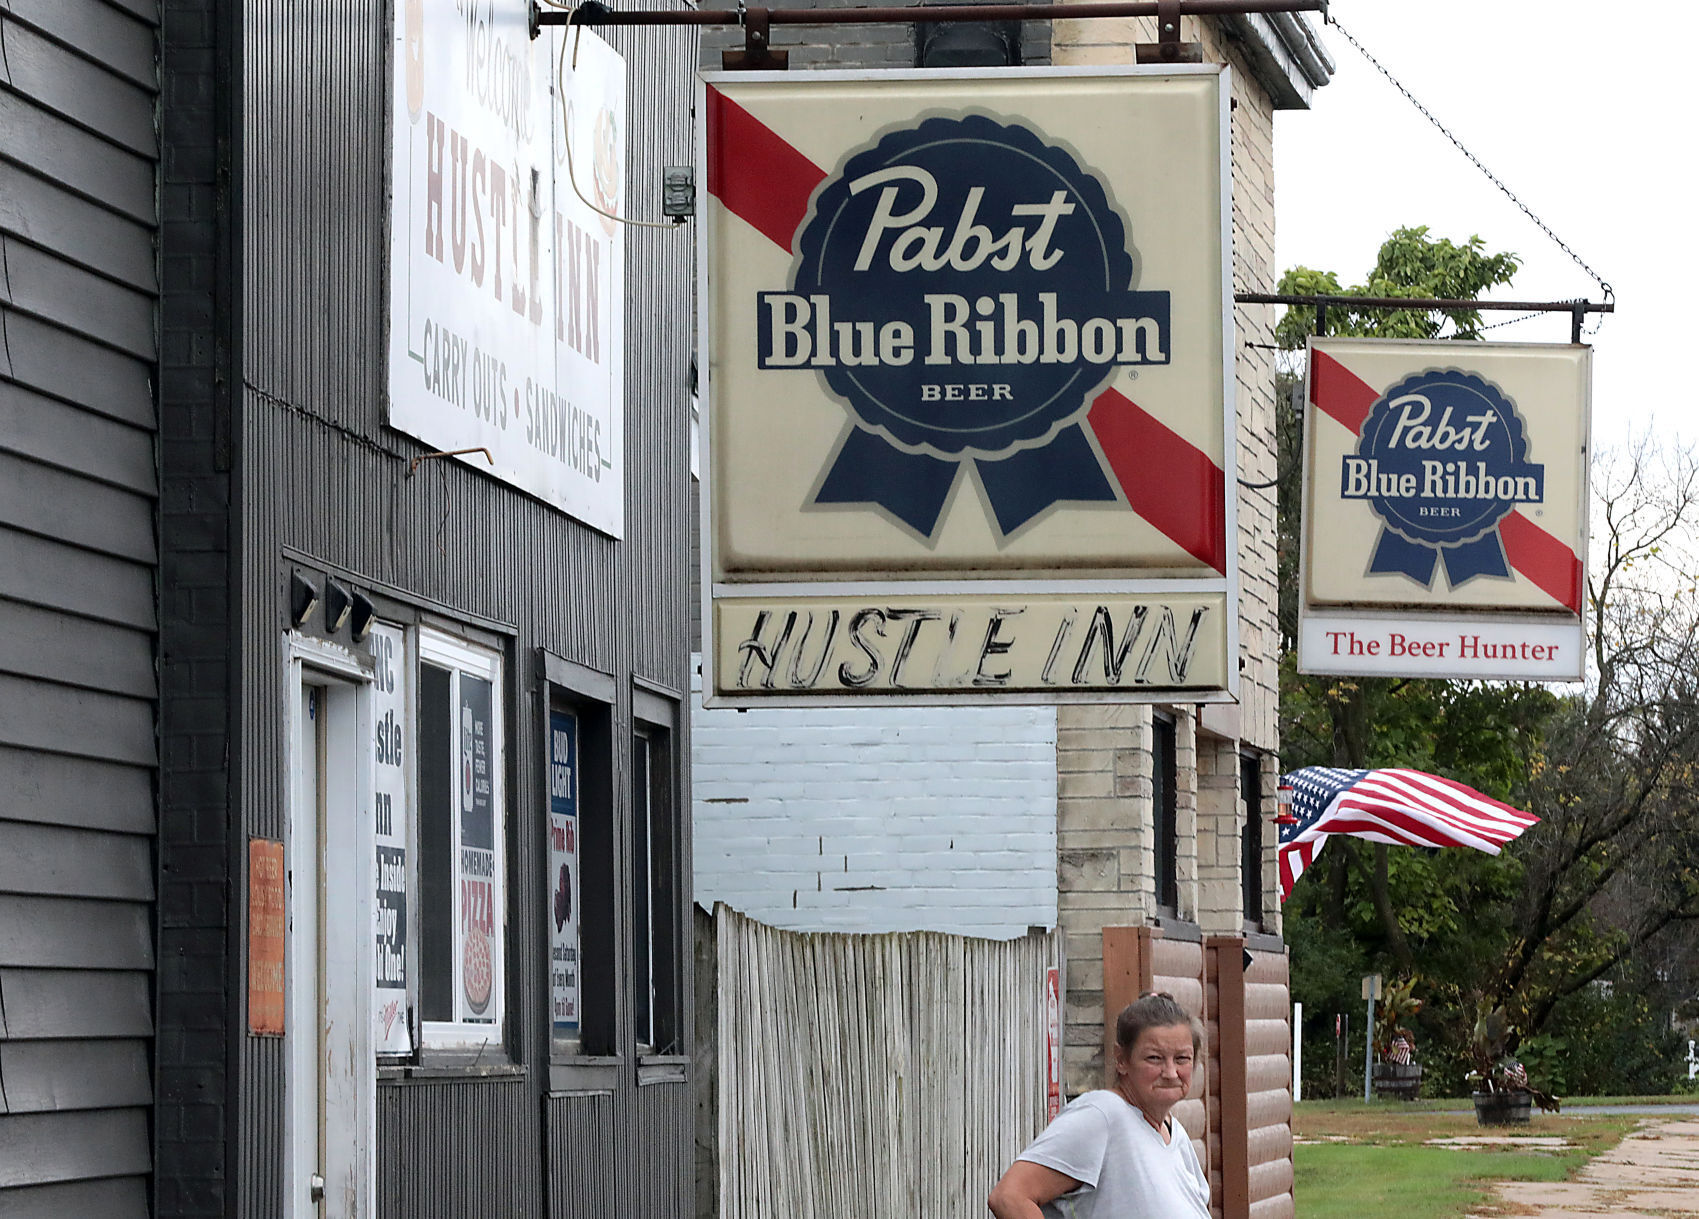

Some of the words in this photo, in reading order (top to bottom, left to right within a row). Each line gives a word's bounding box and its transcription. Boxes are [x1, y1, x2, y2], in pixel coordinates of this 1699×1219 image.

[849, 165, 1076, 272] Pabst
[556, 210, 600, 365] INN
[763, 294, 915, 367] Blue
[924, 292, 1166, 366] Ribbon
[423, 318, 467, 411] CARRY
[472, 347, 507, 431] OUTS
[525, 376, 601, 483] SANDWICHES
[921, 383, 1014, 402] BEER
[1388, 394, 1498, 451] Pabst
[1343, 457, 1417, 498] Blue
[1420, 459, 1540, 501] Ribbon
[1419, 506, 1461, 518] BEER
[1041, 605, 1211, 685] INN
[1325, 631, 1380, 656] The
[1388, 633, 1450, 659] Beer
[1458, 634, 1559, 661] Hunter
[553, 729, 569, 764] BUD
[551, 763, 572, 799] LIGHT
[380, 853, 406, 893] Inside
[461, 849, 493, 878] HOMEMADE
[461, 880, 494, 938] PIZZA
[385, 943, 405, 982] One!
